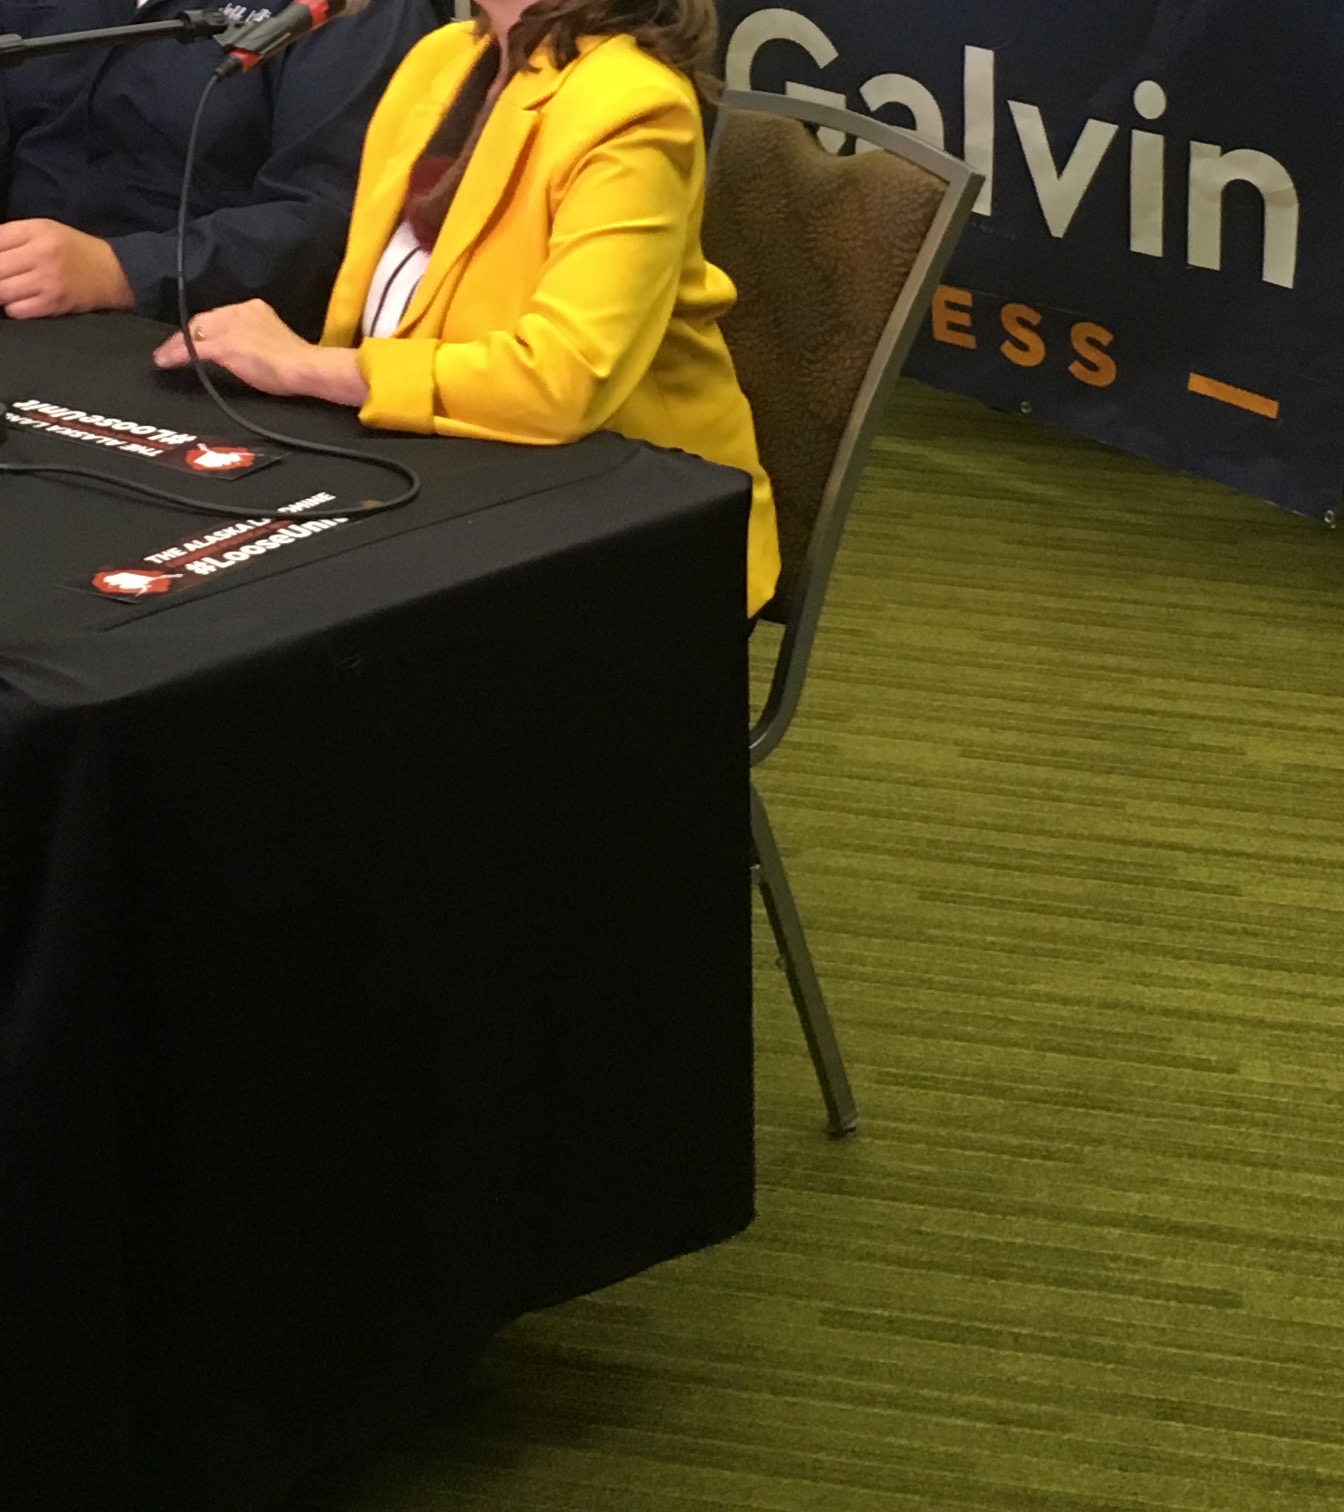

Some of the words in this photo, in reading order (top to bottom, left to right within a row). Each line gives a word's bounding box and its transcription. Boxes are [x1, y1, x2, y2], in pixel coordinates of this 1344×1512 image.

[725, 7, 1300, 289] Galvin
[12, 399, 197, 445] #LooseUnit
[45, 423, 122, 447] ALASKA
[119, 442, 164, 457] THE
[144, 546, 187, 565] THE
[182, 525, 254, 554] ALASKA
[247, 491, 336, 526] LMINE
[185, 517, 349, 575] #LooseUni
